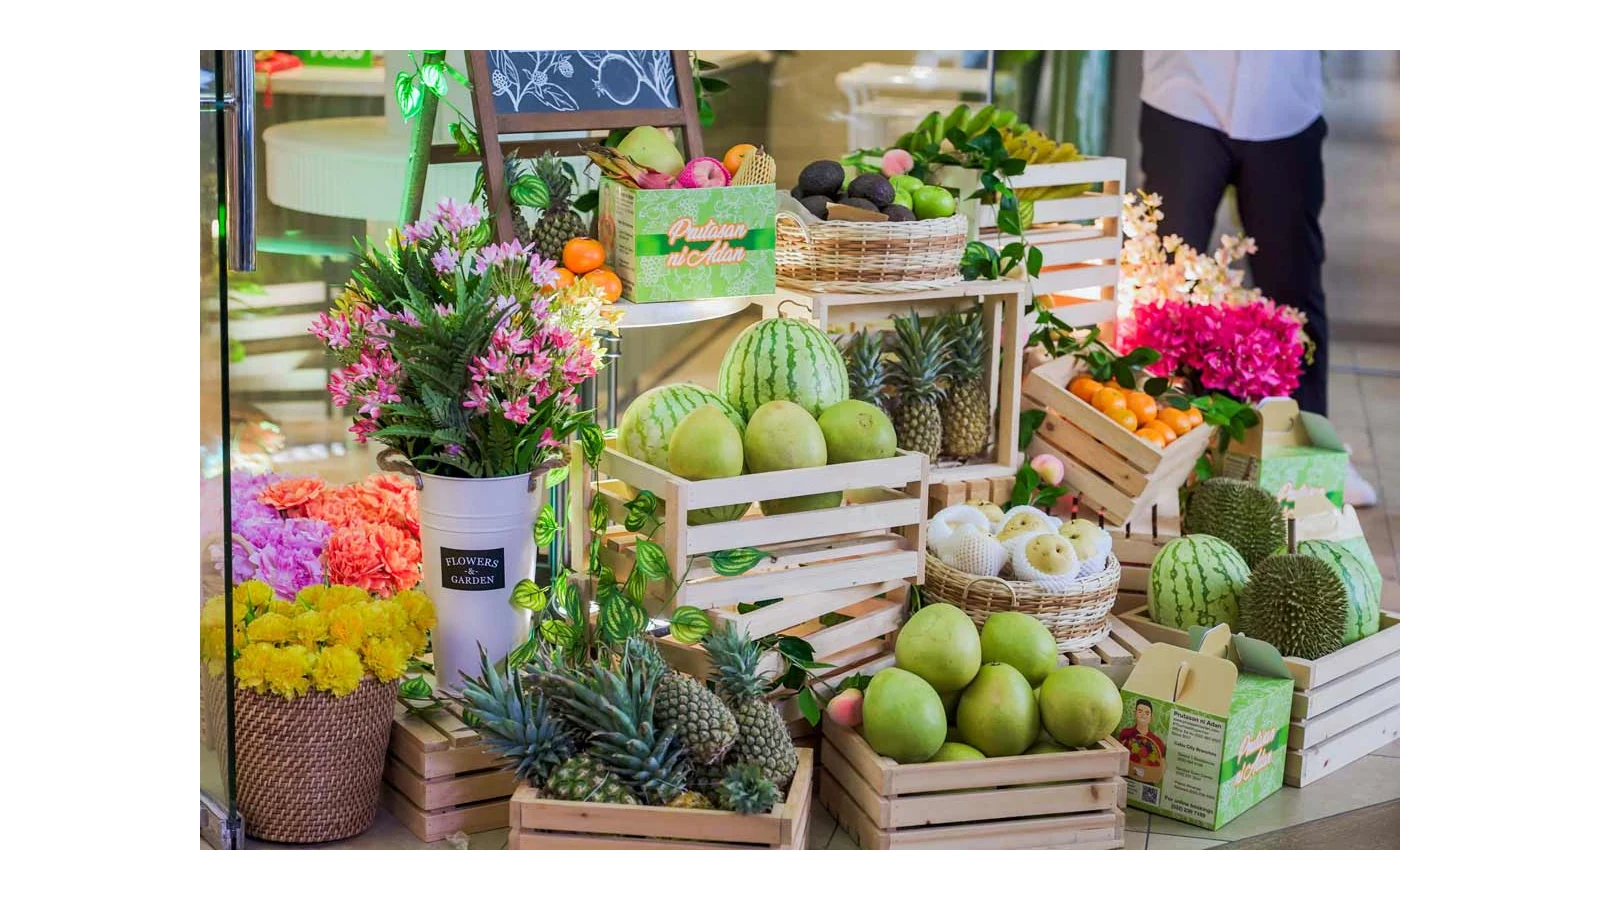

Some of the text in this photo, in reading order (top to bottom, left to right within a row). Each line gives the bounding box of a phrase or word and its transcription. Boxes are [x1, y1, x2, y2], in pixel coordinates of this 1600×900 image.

[667, 216, 748, 245] Prutasan
[666, 240, 746, 268] ni Adan
[445, 556, 499, 568] FLOWERS
[450, 575, 495, 585] GARDEN
